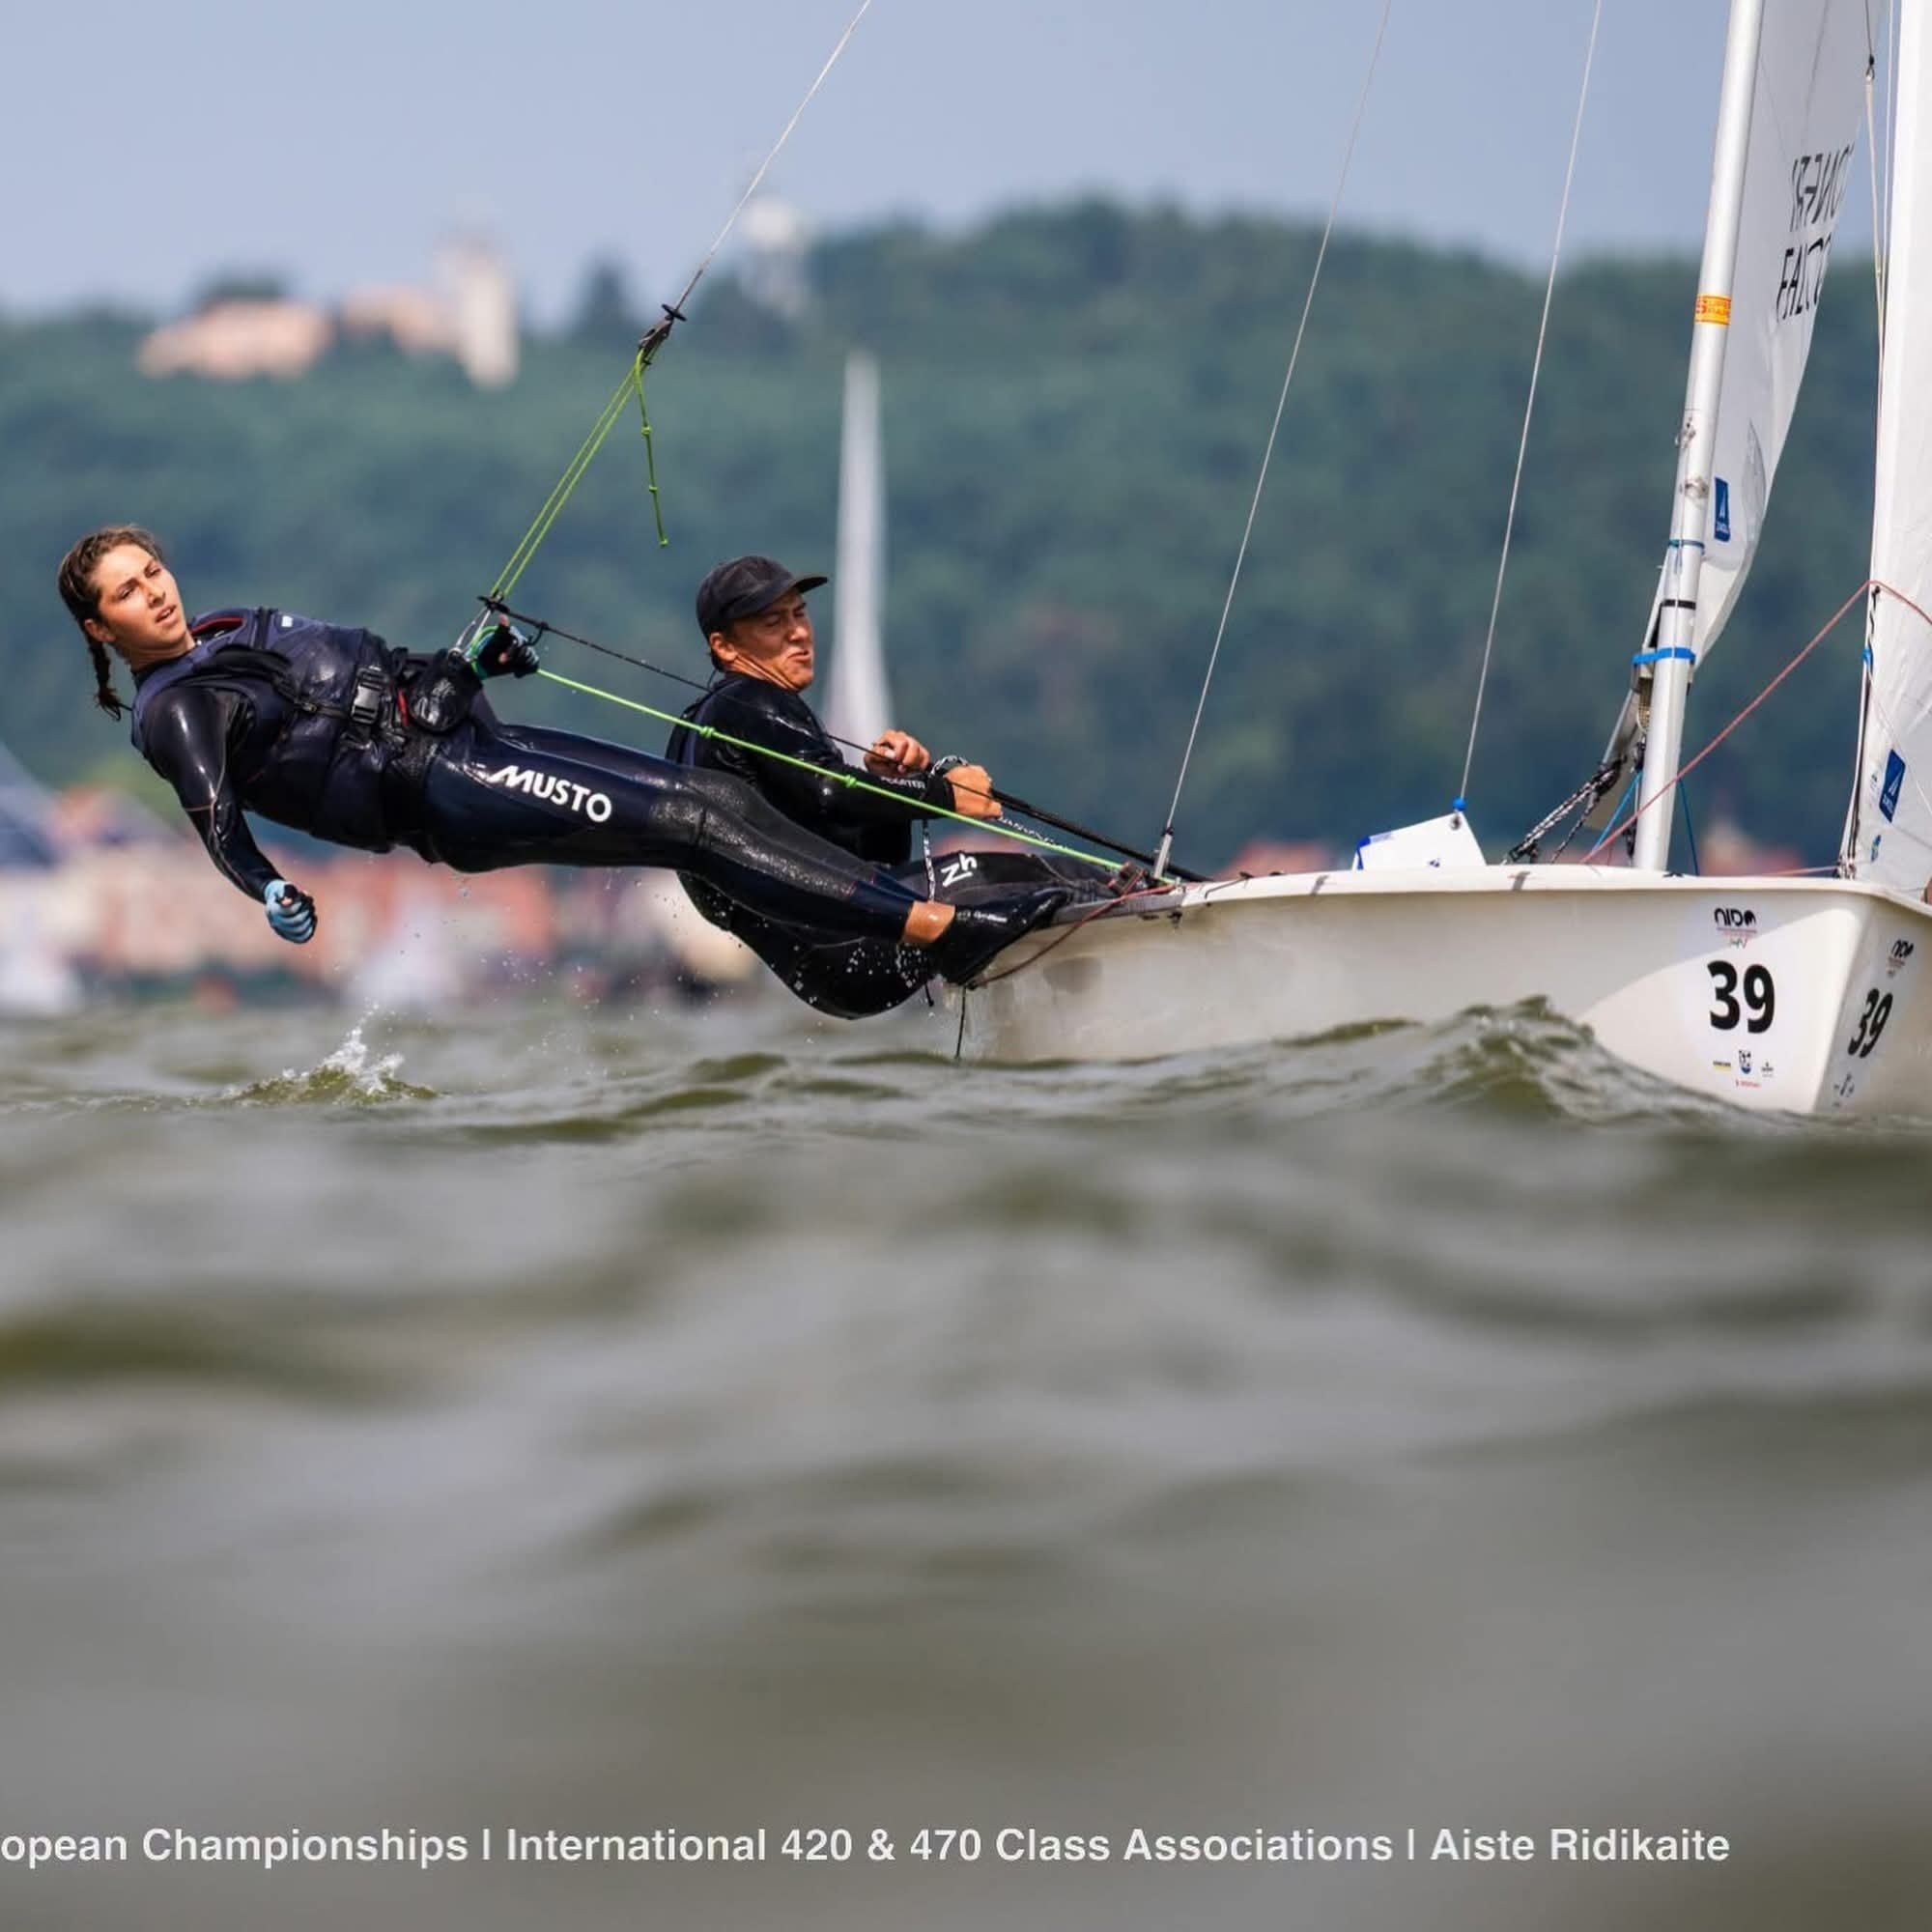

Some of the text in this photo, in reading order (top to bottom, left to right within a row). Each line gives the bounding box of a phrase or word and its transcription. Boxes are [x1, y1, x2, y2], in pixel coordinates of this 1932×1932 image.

[486, 764, 612, 823] MUSTO
[1707, 960, 1776, 1034] 39
[1847, 988, 1894, 1059] 39
